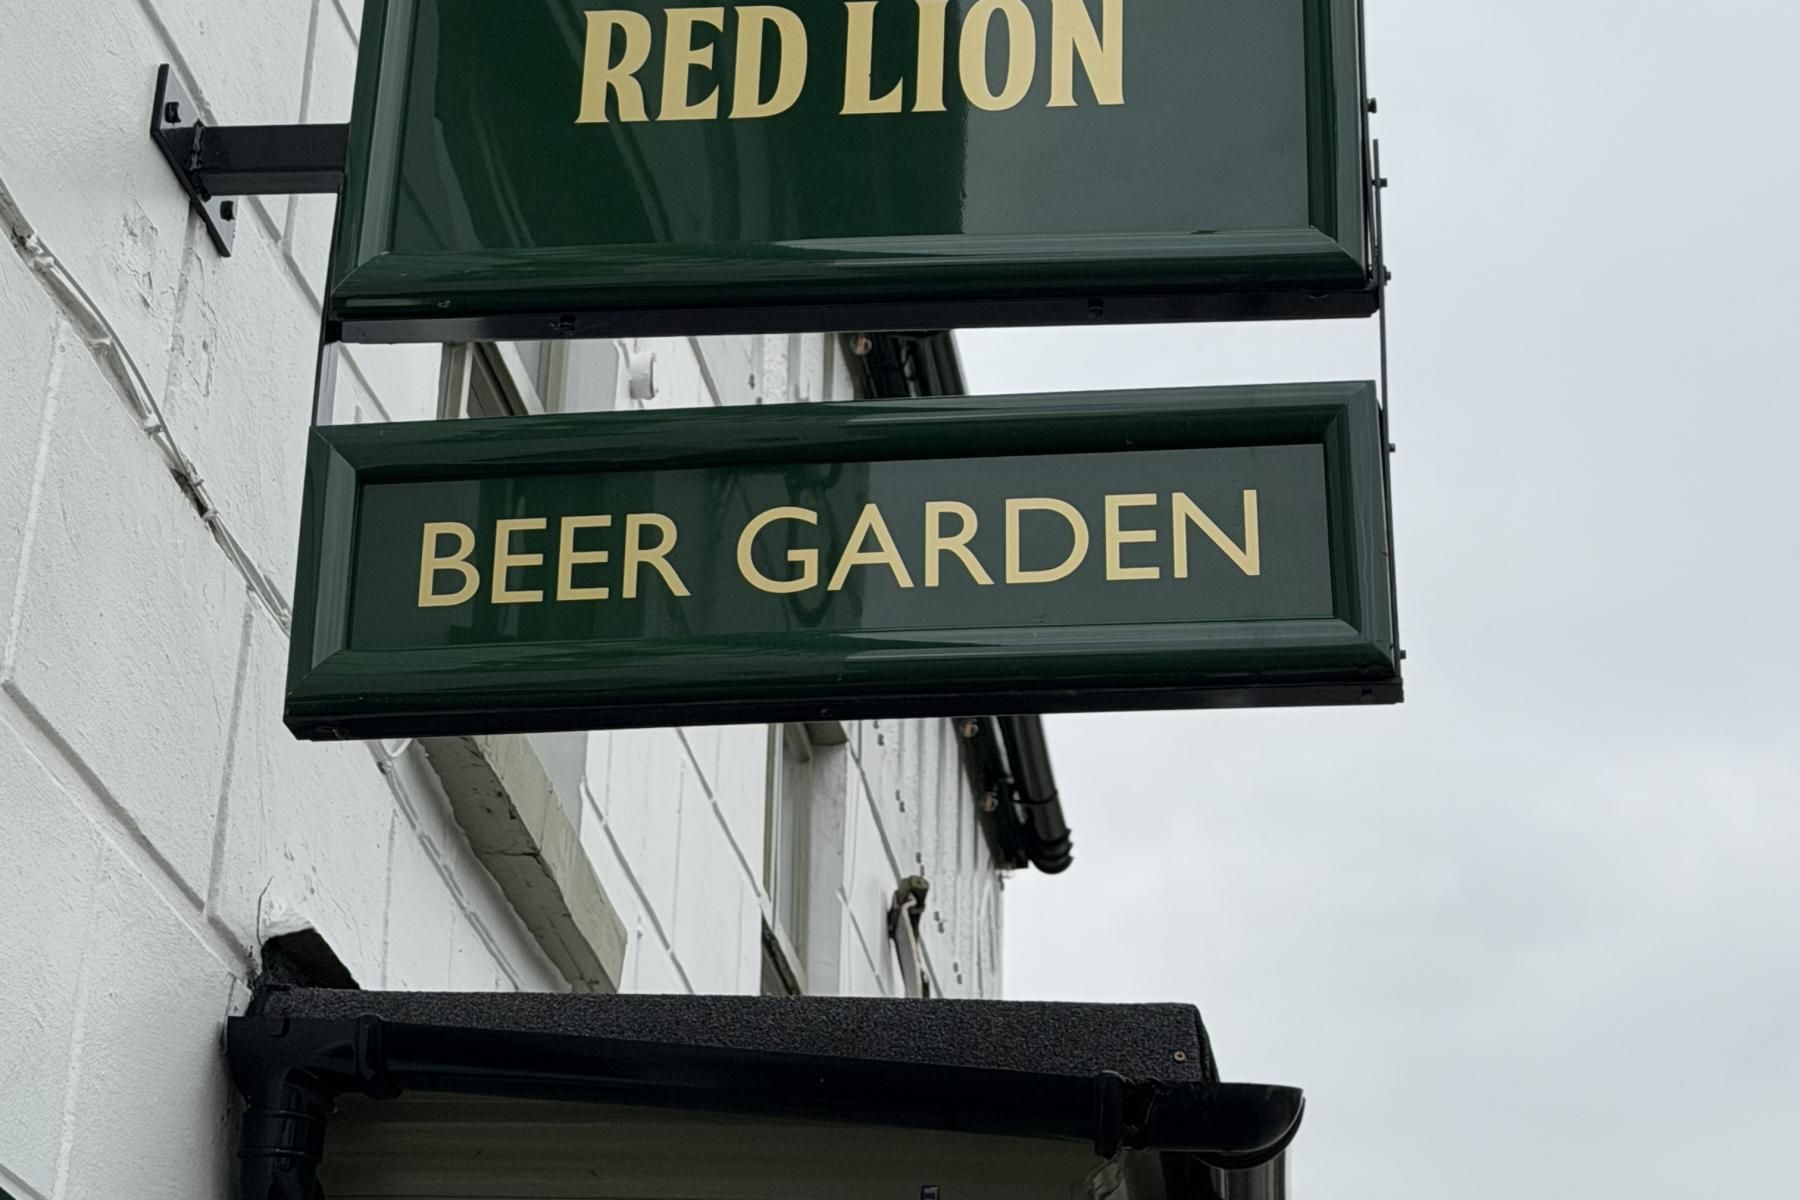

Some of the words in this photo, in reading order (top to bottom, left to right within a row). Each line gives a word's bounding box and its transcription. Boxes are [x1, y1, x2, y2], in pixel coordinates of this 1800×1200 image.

[573, 4, 809, 125] RED
[416, 511, 692, 608] BEER
[736, 488, 1261, 593] GARDEN
